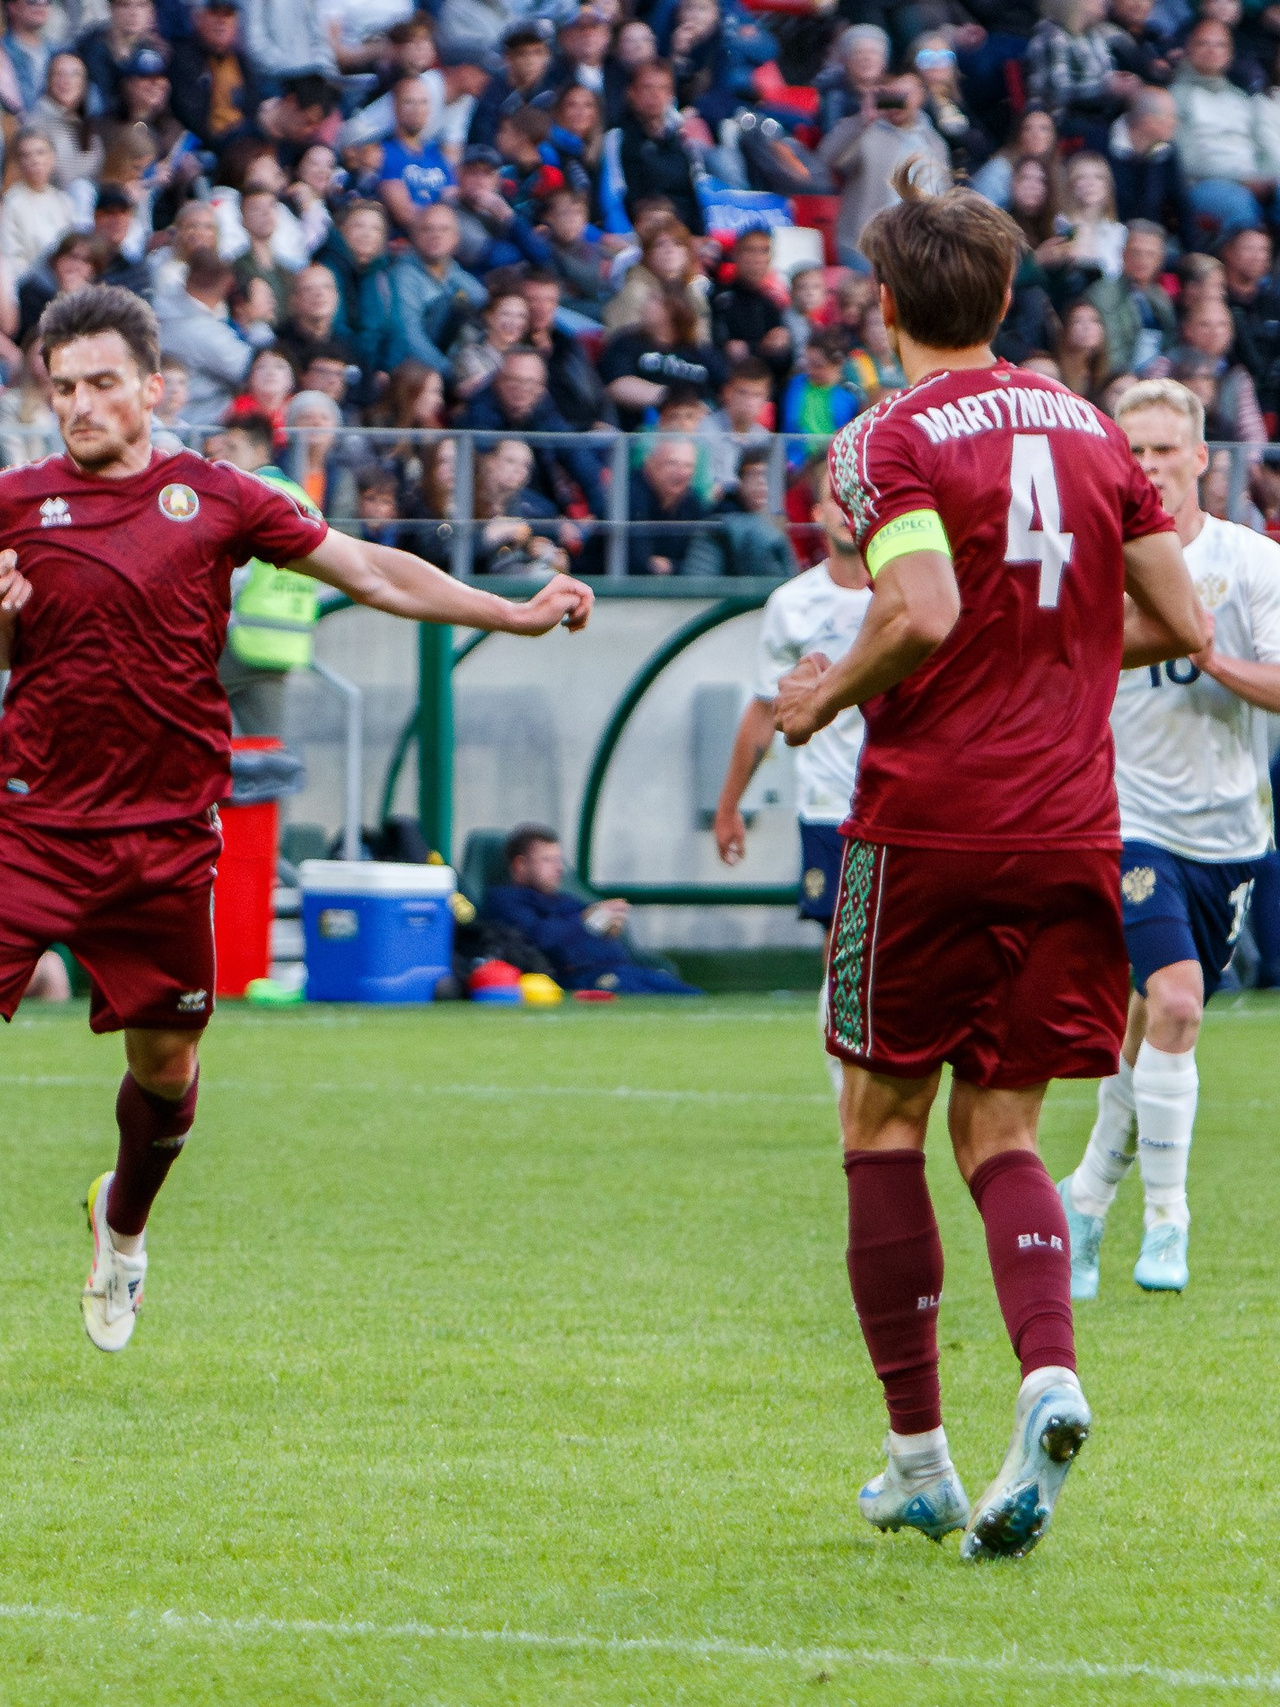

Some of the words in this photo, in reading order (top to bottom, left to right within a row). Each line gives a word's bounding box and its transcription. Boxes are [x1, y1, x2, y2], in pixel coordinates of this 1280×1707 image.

[879, 519, 933, 541] RESPECT
[1004, 433, 1073, 607] 4
[1226, 877, 1255, 945] 1
[1017, 1232, 1063, 1251] BLR
